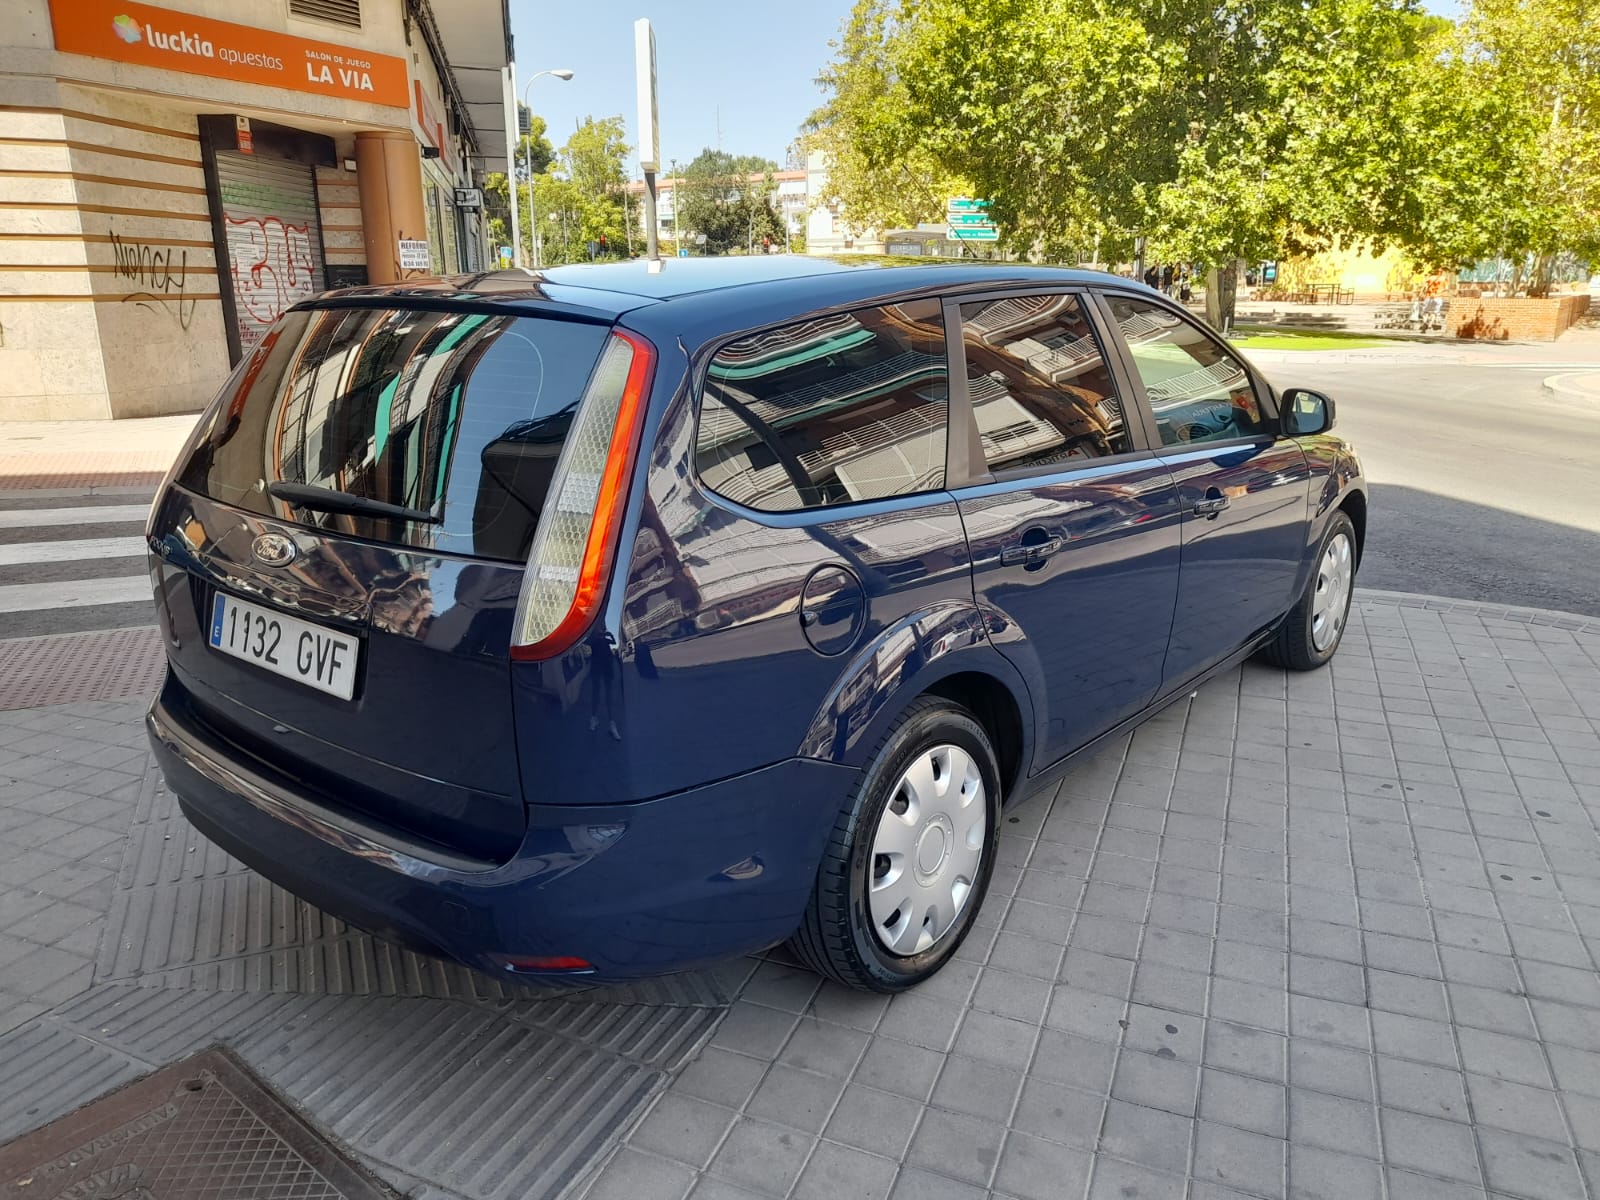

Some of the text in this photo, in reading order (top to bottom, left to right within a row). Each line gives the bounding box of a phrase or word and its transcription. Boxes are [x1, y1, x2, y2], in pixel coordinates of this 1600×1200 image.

[145, 23, 284, 71] luckia apuestas
[304, 49, 371, 70] SALON DE JUEGO
[306, 62, 375, 92] LA VIA
[257, 538, 279, 559] Ford
[229, 606, 282, 665] 1132
[296, 630, 349, 686] GVF
